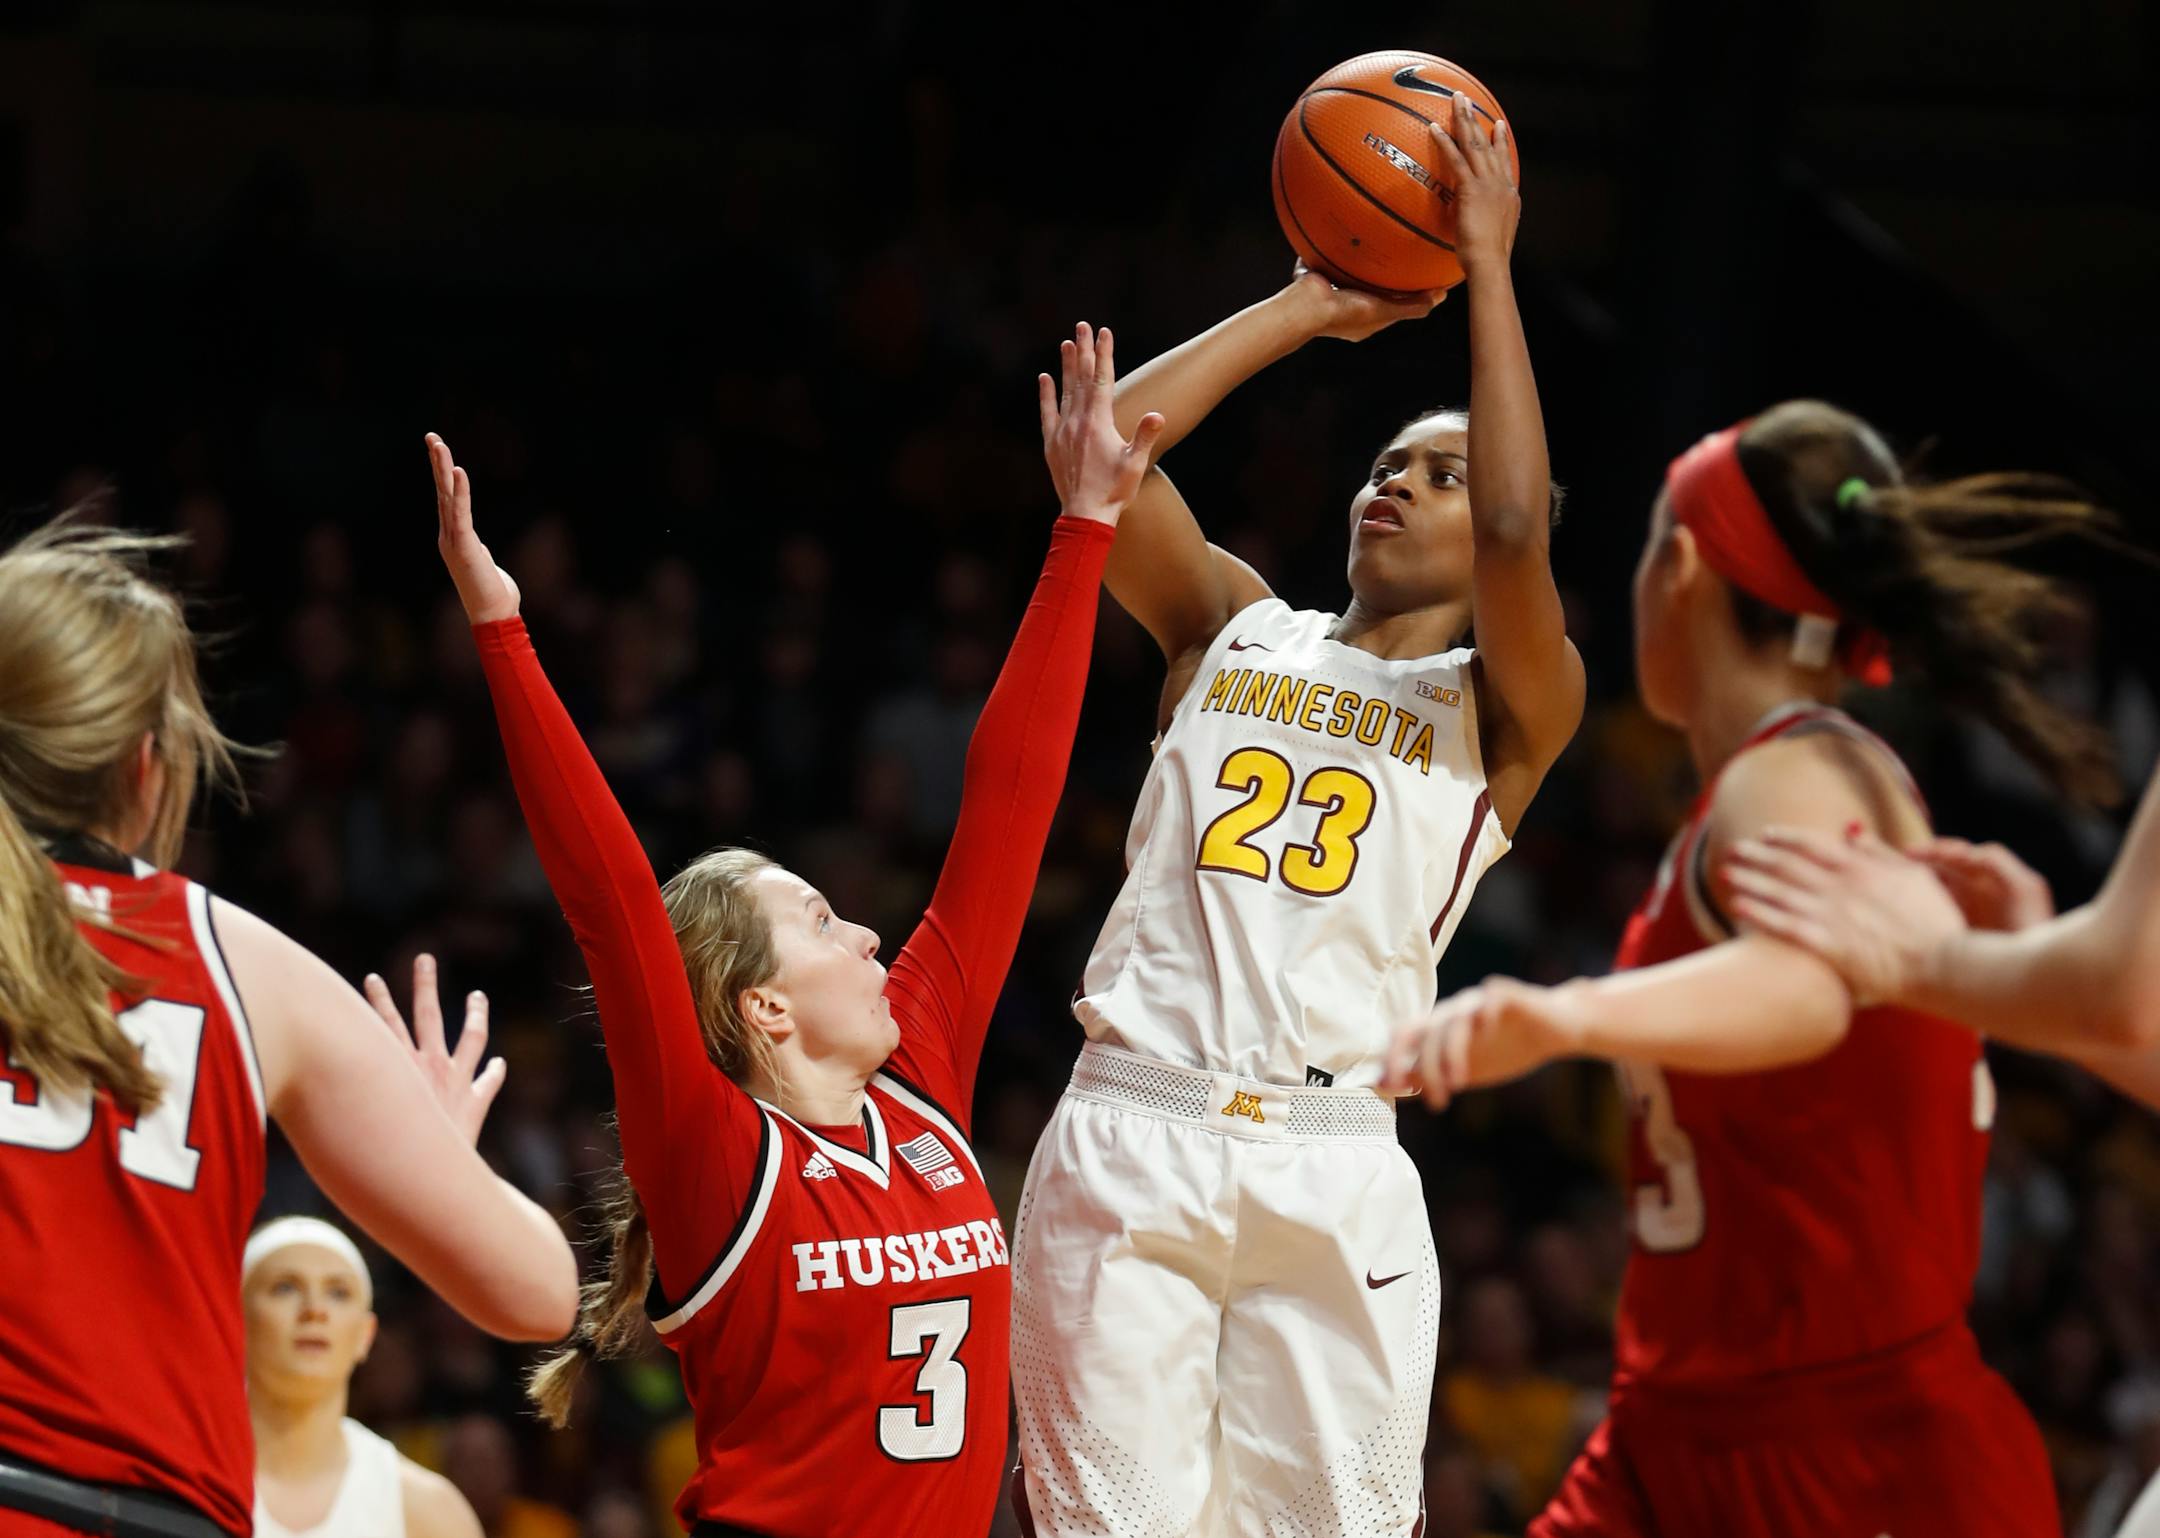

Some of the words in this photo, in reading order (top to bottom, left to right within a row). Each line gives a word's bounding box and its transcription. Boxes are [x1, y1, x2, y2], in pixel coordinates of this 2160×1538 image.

[1201, 668, 1435, 776] MINNESOTA
[1195, 746, 1377, 898] 23
[1221, 1089, 1266, 1124] M
[791, 1217, 1010, 1293] HUSKERS
[874, 1296, 973, 1463] 3
